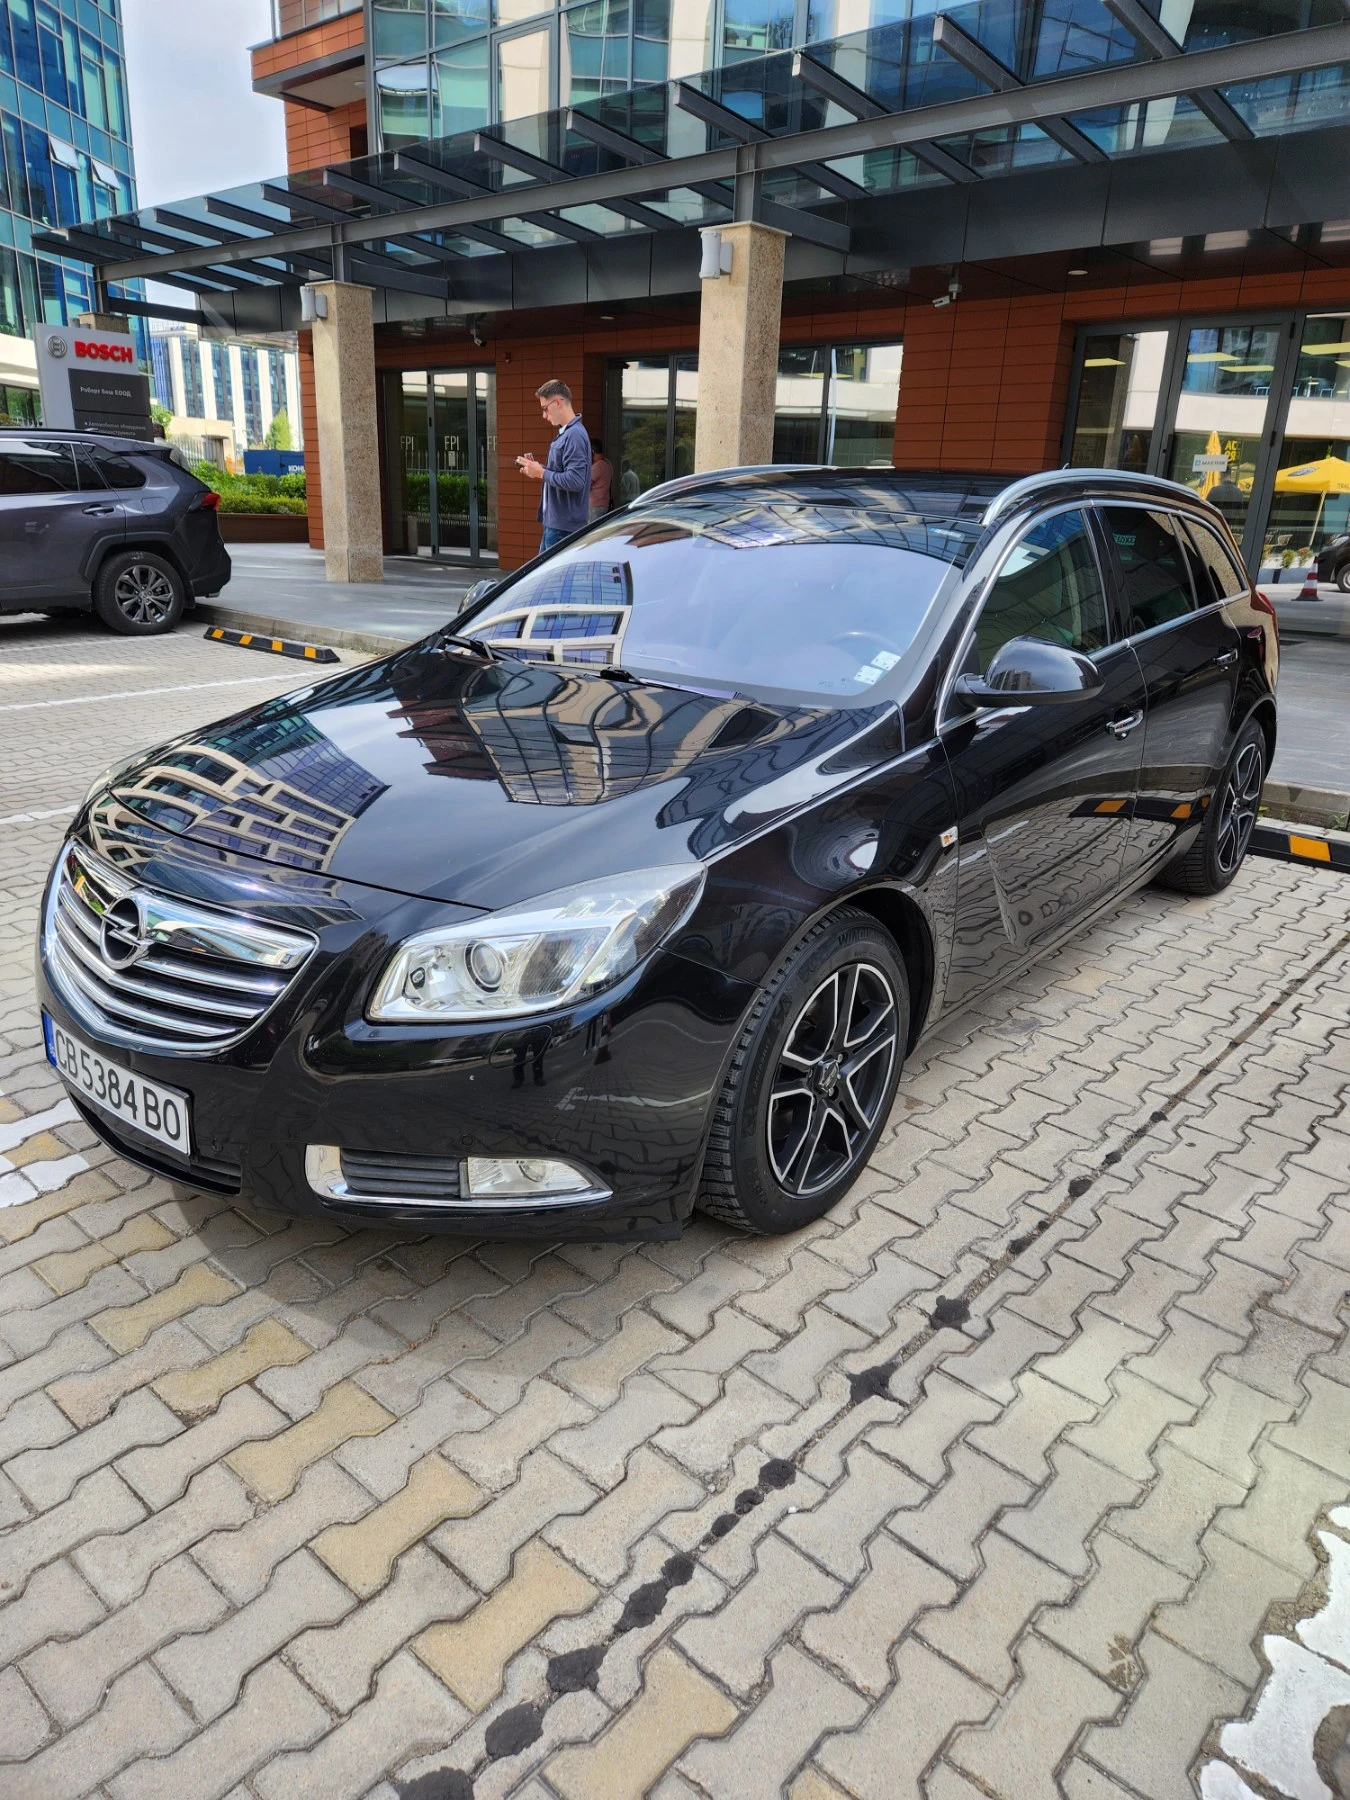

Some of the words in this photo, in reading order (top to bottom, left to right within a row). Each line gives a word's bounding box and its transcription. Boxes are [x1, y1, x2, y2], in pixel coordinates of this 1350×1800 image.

[74, 341, 133, 363] BOSCH
[400, 435, 414, 451] FPI
[444, 435, 460, 451] FPI
